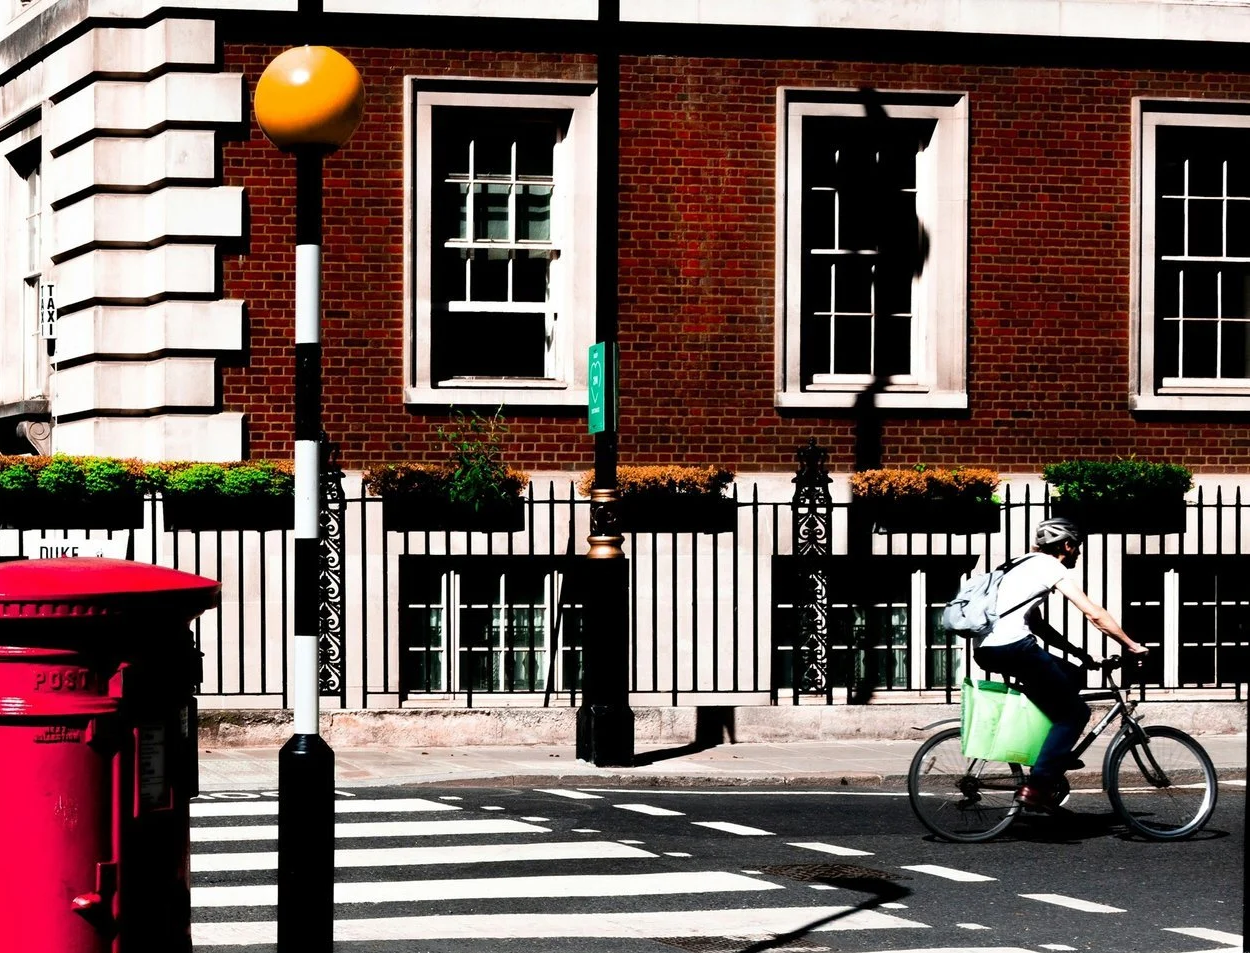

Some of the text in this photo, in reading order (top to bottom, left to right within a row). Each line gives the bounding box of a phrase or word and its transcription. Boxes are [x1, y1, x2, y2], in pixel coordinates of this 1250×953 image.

[47, 284, 55, 336] TAXI
[40, 546, 79, 559] DUKE
[34, 668, 90, 692] POST
